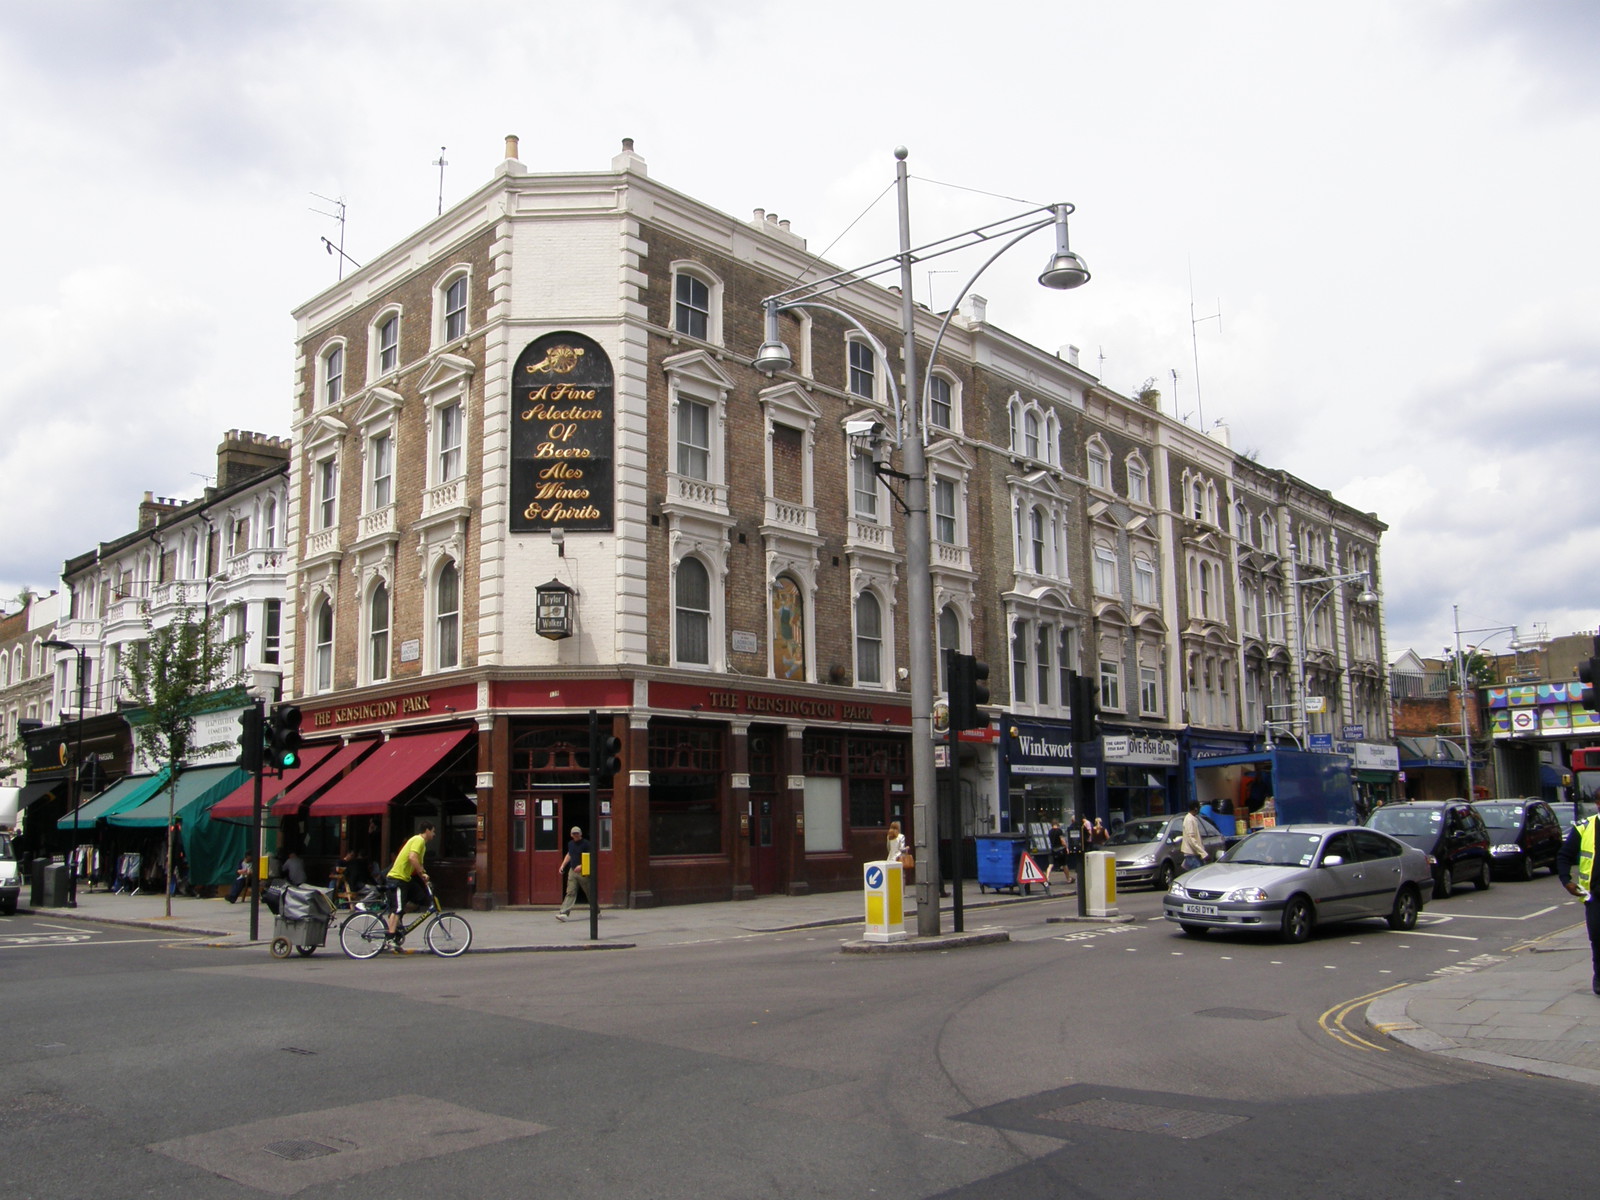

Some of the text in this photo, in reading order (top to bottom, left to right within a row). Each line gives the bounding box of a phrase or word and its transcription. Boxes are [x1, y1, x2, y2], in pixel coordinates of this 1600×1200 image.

[528, 382, 596, 401] A Fine
[521, 403, 603, 420] Selection
[548, 422, 578, 442] Of
[534, 441, 591, 458] Beers
[539, 461, 583, 479] Ales
[534, 481, 590, 499] Wines
[524, 502, 601, 523] & Spirits
[542, 618, 563, 629] Walker
[314, 694, 431, 727] THE KENSINGTON PARK
[709, 691, 874, 721] THE KENSINGTON PARK
[1018, 735, 1073, 758] Winkwort
[1129, 740, 1170, 756] OVE FISH BAR
